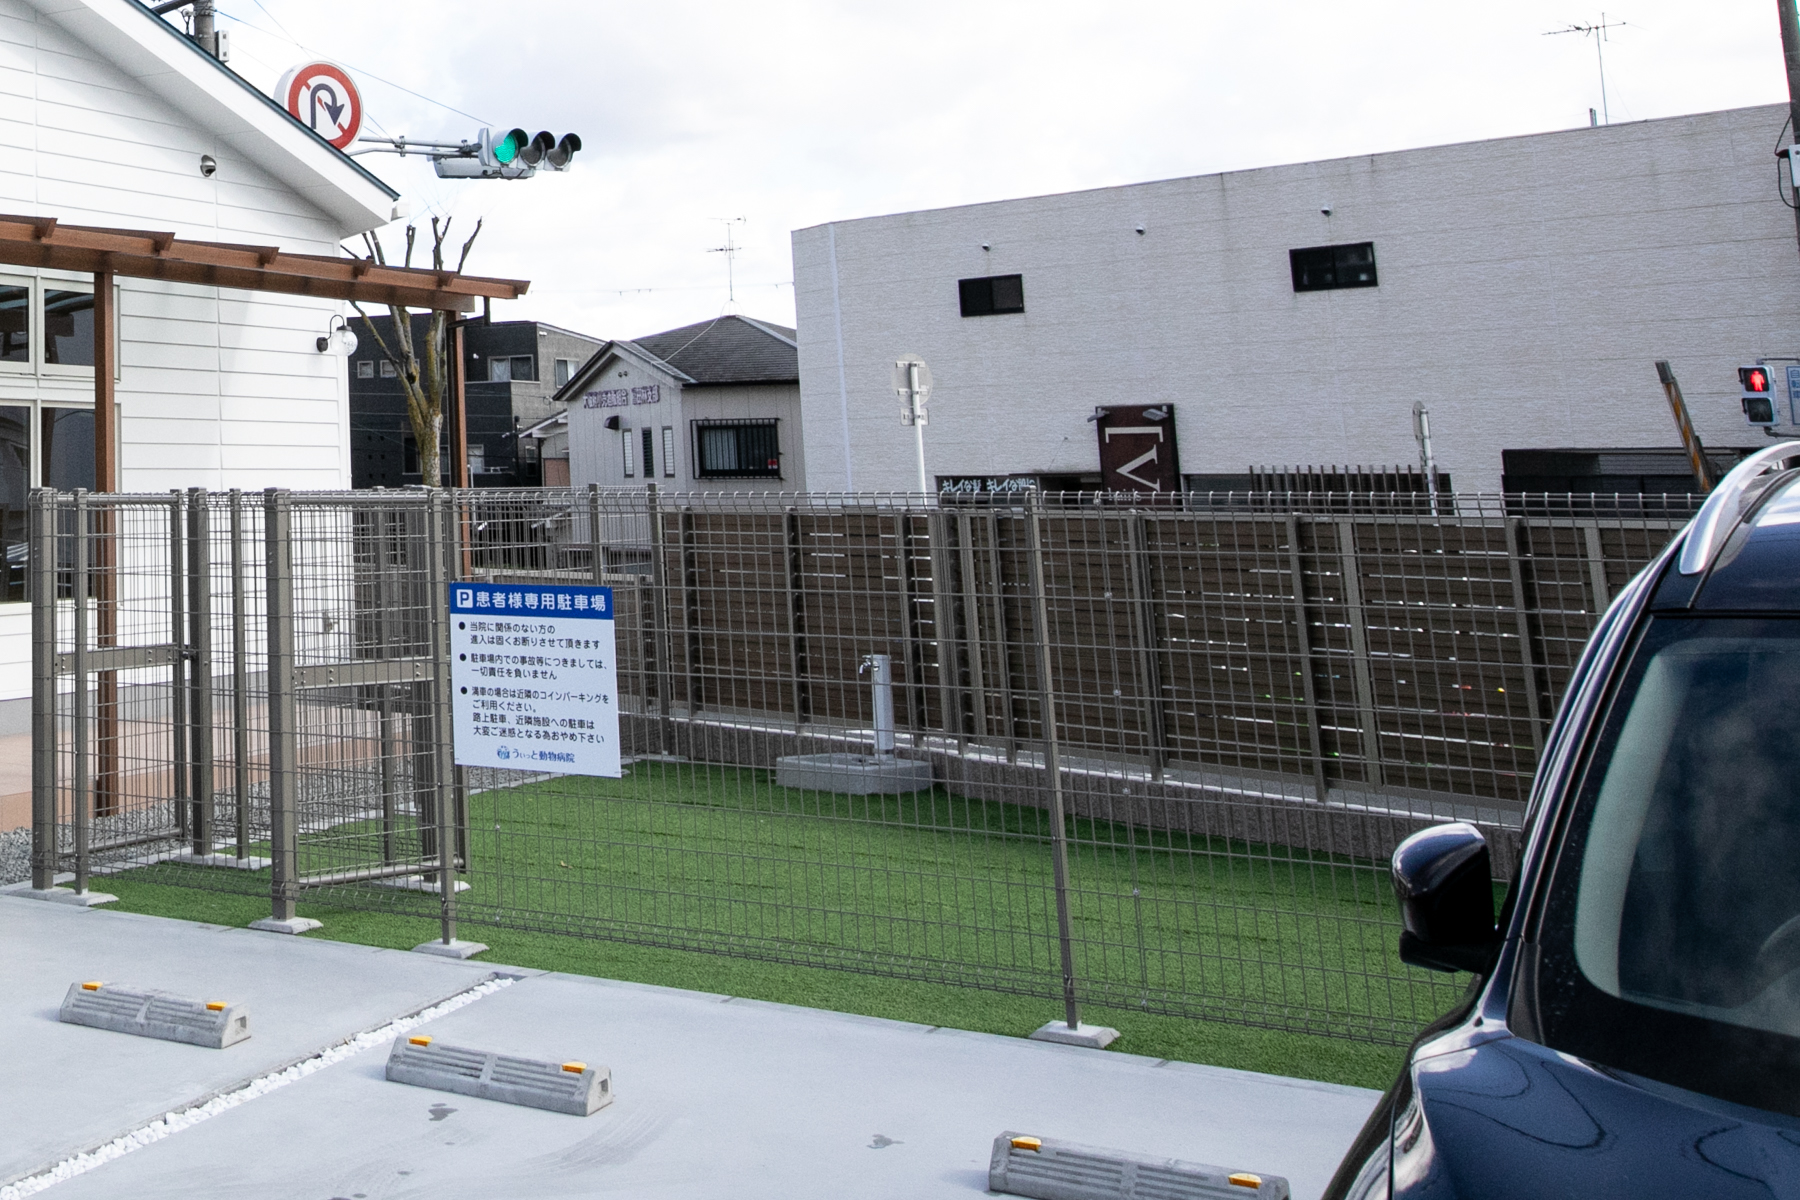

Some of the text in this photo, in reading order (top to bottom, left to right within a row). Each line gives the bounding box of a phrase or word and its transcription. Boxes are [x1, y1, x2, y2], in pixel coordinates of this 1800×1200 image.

[476, 591, 605, 612] 患者様専用駐車場
[470, 621, 555, 634] 当院に関係のない方の
[470, 634, 600, 649] 進入は固くお断りさせて頂きます
[471, 666, 558, 680] 一切責任を負いません
[473, 725, 604, 743] 大変ご迷惑となる為おやめ下さい
